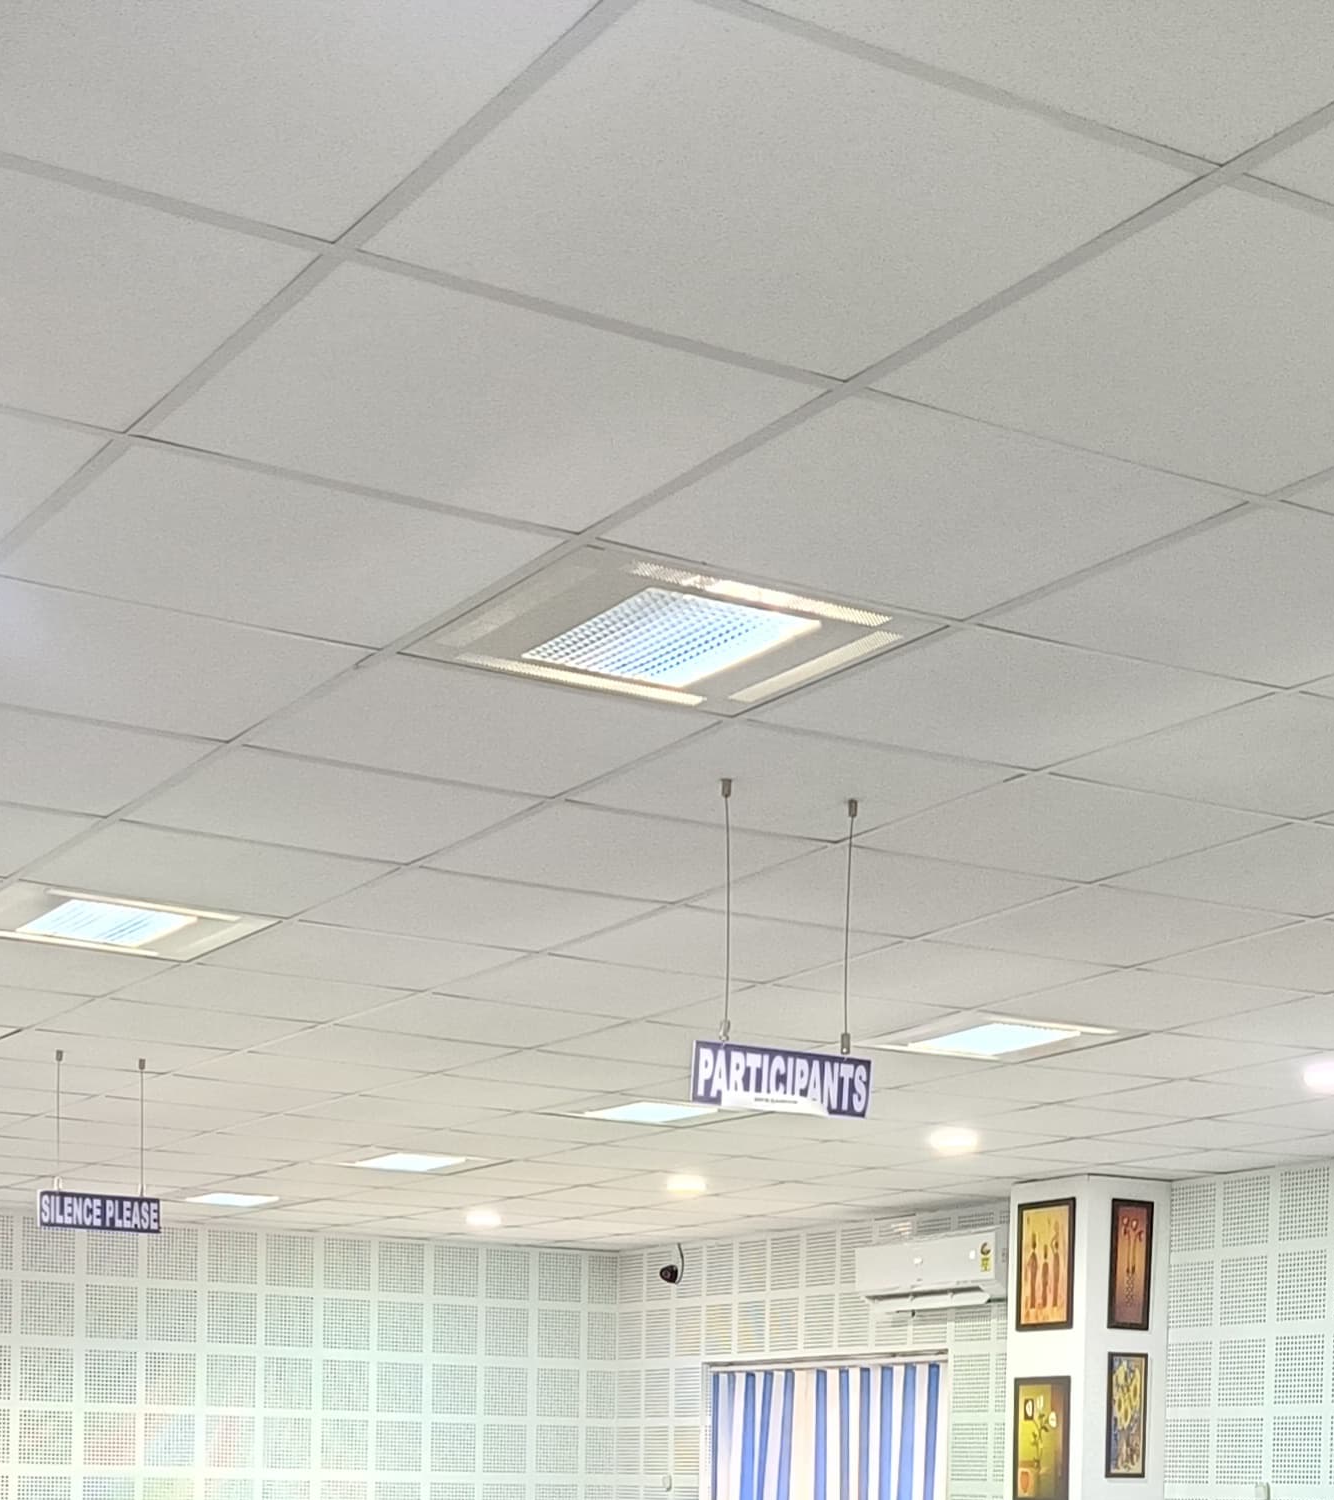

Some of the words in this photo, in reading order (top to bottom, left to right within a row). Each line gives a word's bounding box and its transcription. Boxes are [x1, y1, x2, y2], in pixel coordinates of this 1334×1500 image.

[696, 1047, 868, 1113] PARTICIPANTS
[41, 1194, 102, 1227] SILENCE
[106, 1199, 159, 1230] PLEASE
